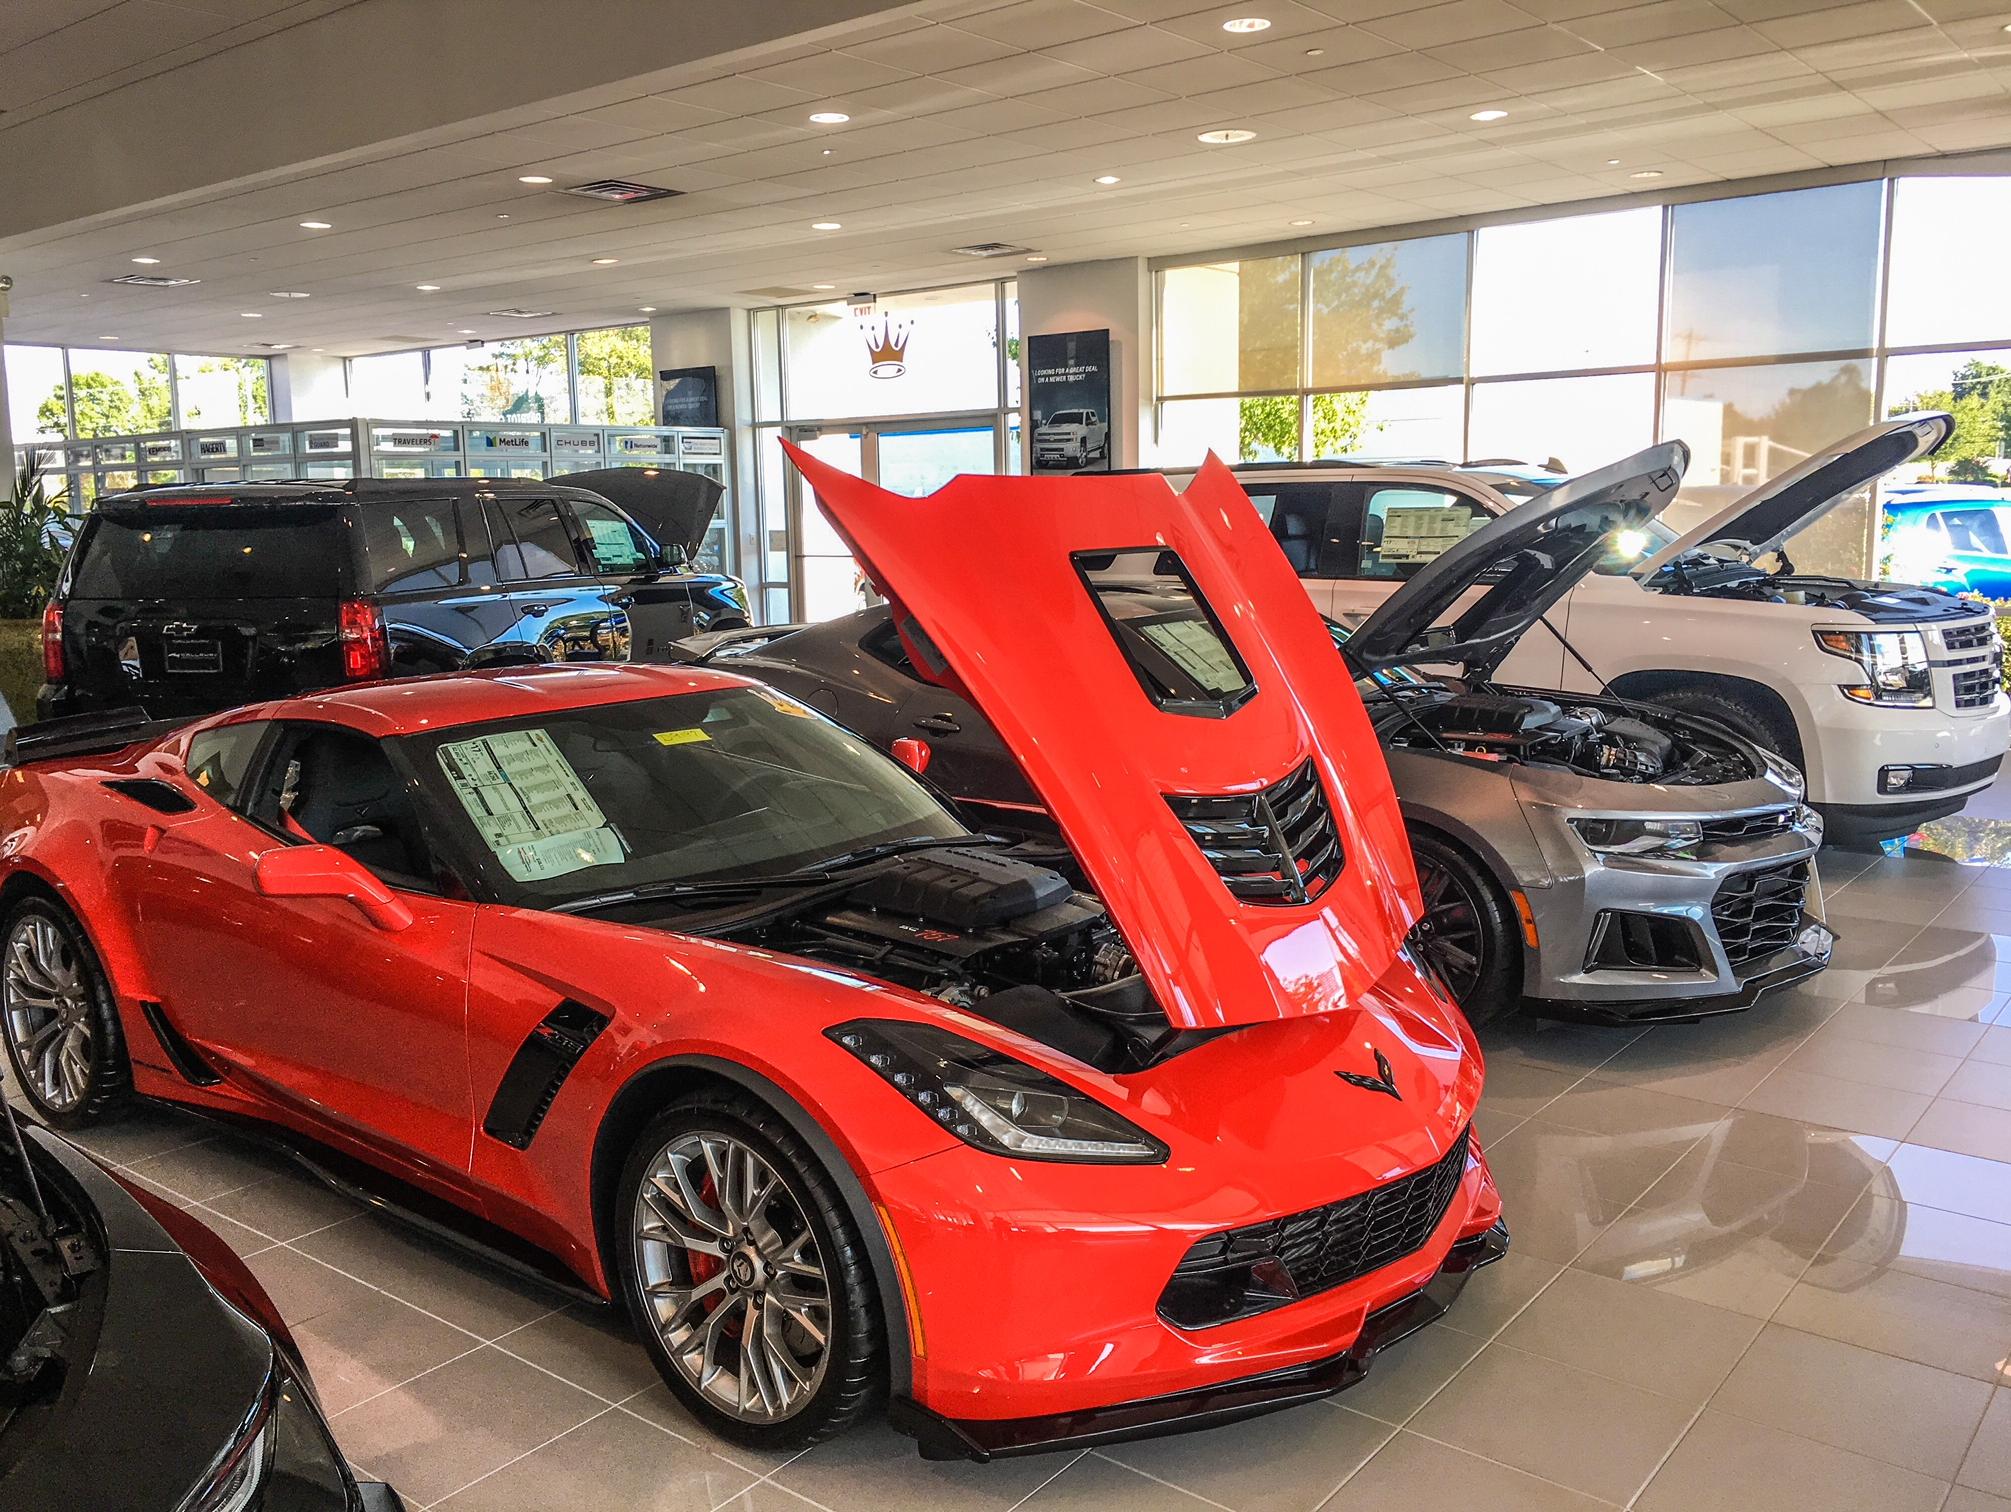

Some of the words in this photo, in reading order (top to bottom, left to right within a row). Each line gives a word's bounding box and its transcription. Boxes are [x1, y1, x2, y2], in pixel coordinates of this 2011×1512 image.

[1035, 368, 1055, 376] LOOKING
[1055, 367, 1065, 375] FOR
[1069, 366, 1085, 374] GREAT
[1085, 365, 1098, 373] DEAL
[1049, 375, 1067, 383] NEWER
[1067, 373, 1086, 382] TRUCK?
[392, 437, 432, 447] TRAVELERS
[499, 437, 530, 447] MetLife
[556, 439, 596, 447] CHUBB
